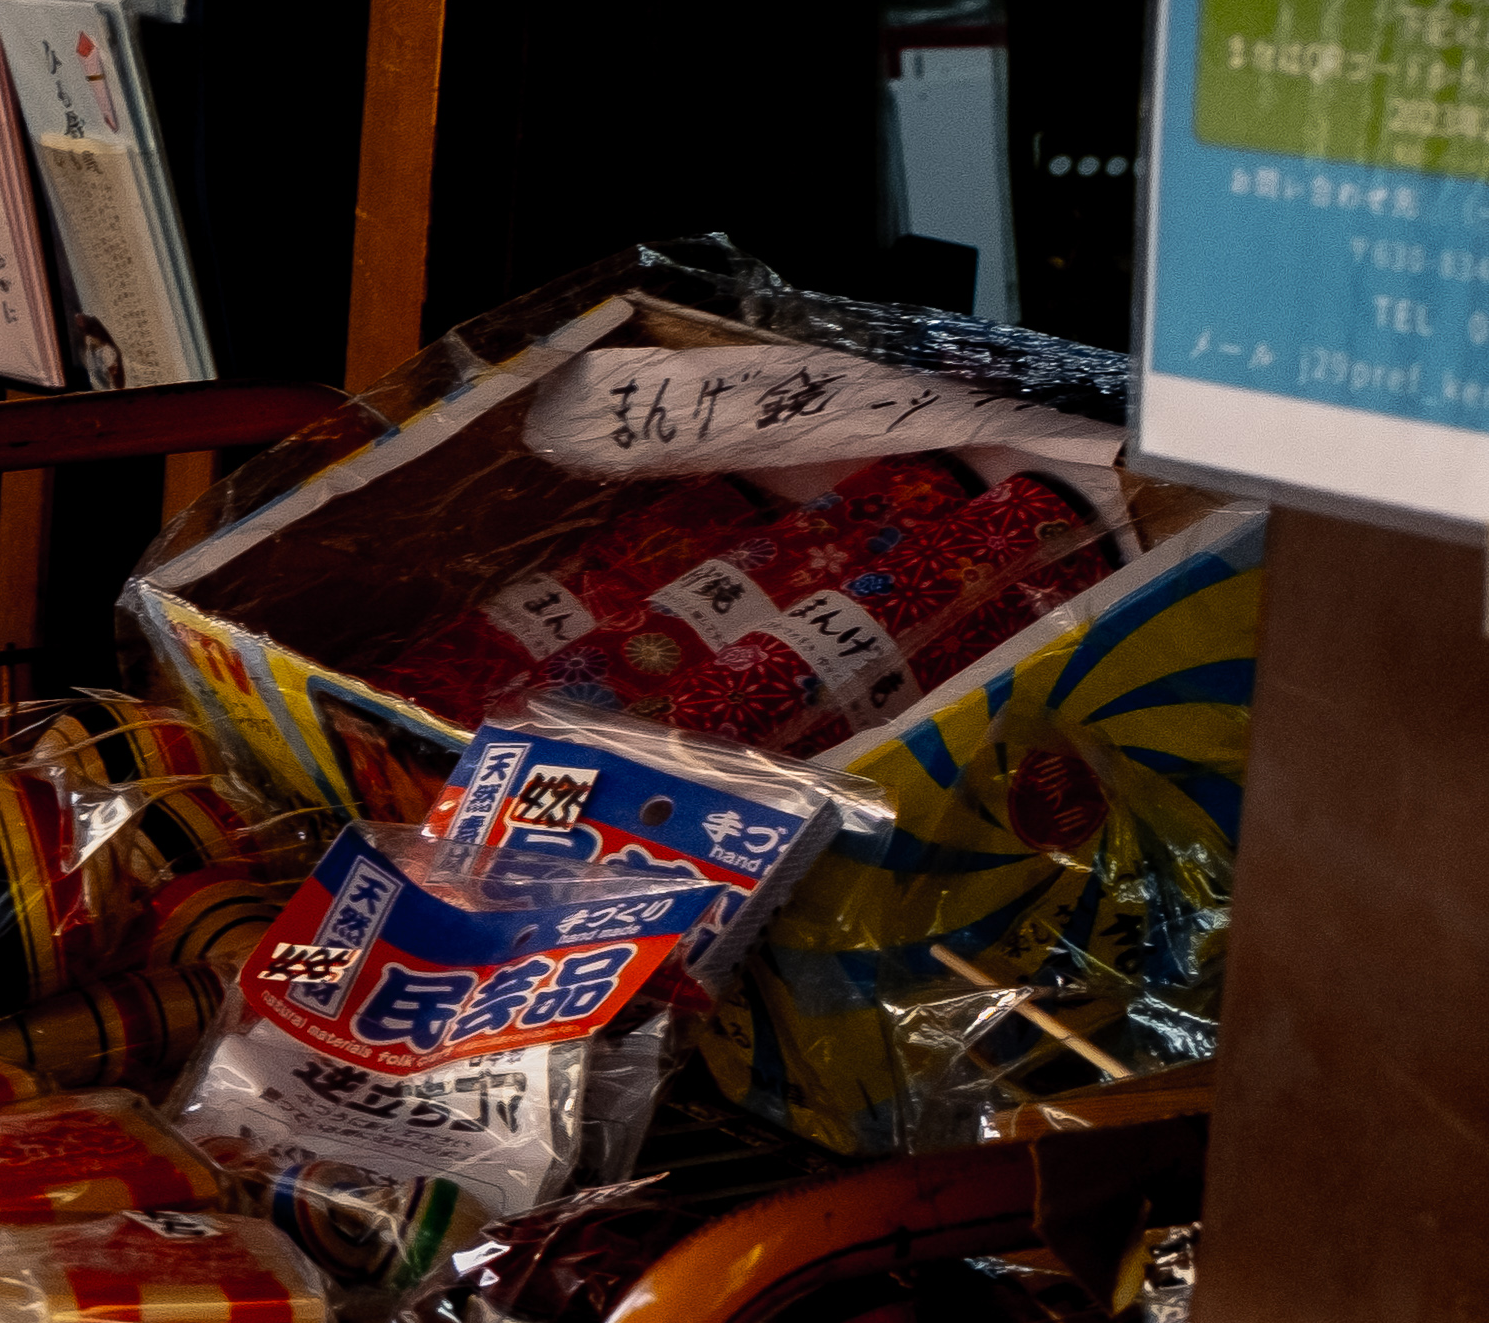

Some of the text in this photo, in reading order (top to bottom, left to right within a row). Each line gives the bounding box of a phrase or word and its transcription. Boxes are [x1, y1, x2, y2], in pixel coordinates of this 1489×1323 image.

[1373, 293, 1435, 338] TEL
[1188, 325, 1276, 370] メール
[708, 842, 763, 870] hand
[555, 897, 675, 934] 手づくり
[303, 875, 390, 1008] 天然材
[353, 941, 637, 1054] 民芸品
[307, 1026, 374, 1068] materials
[378, 1048, 413, 1069] folk
